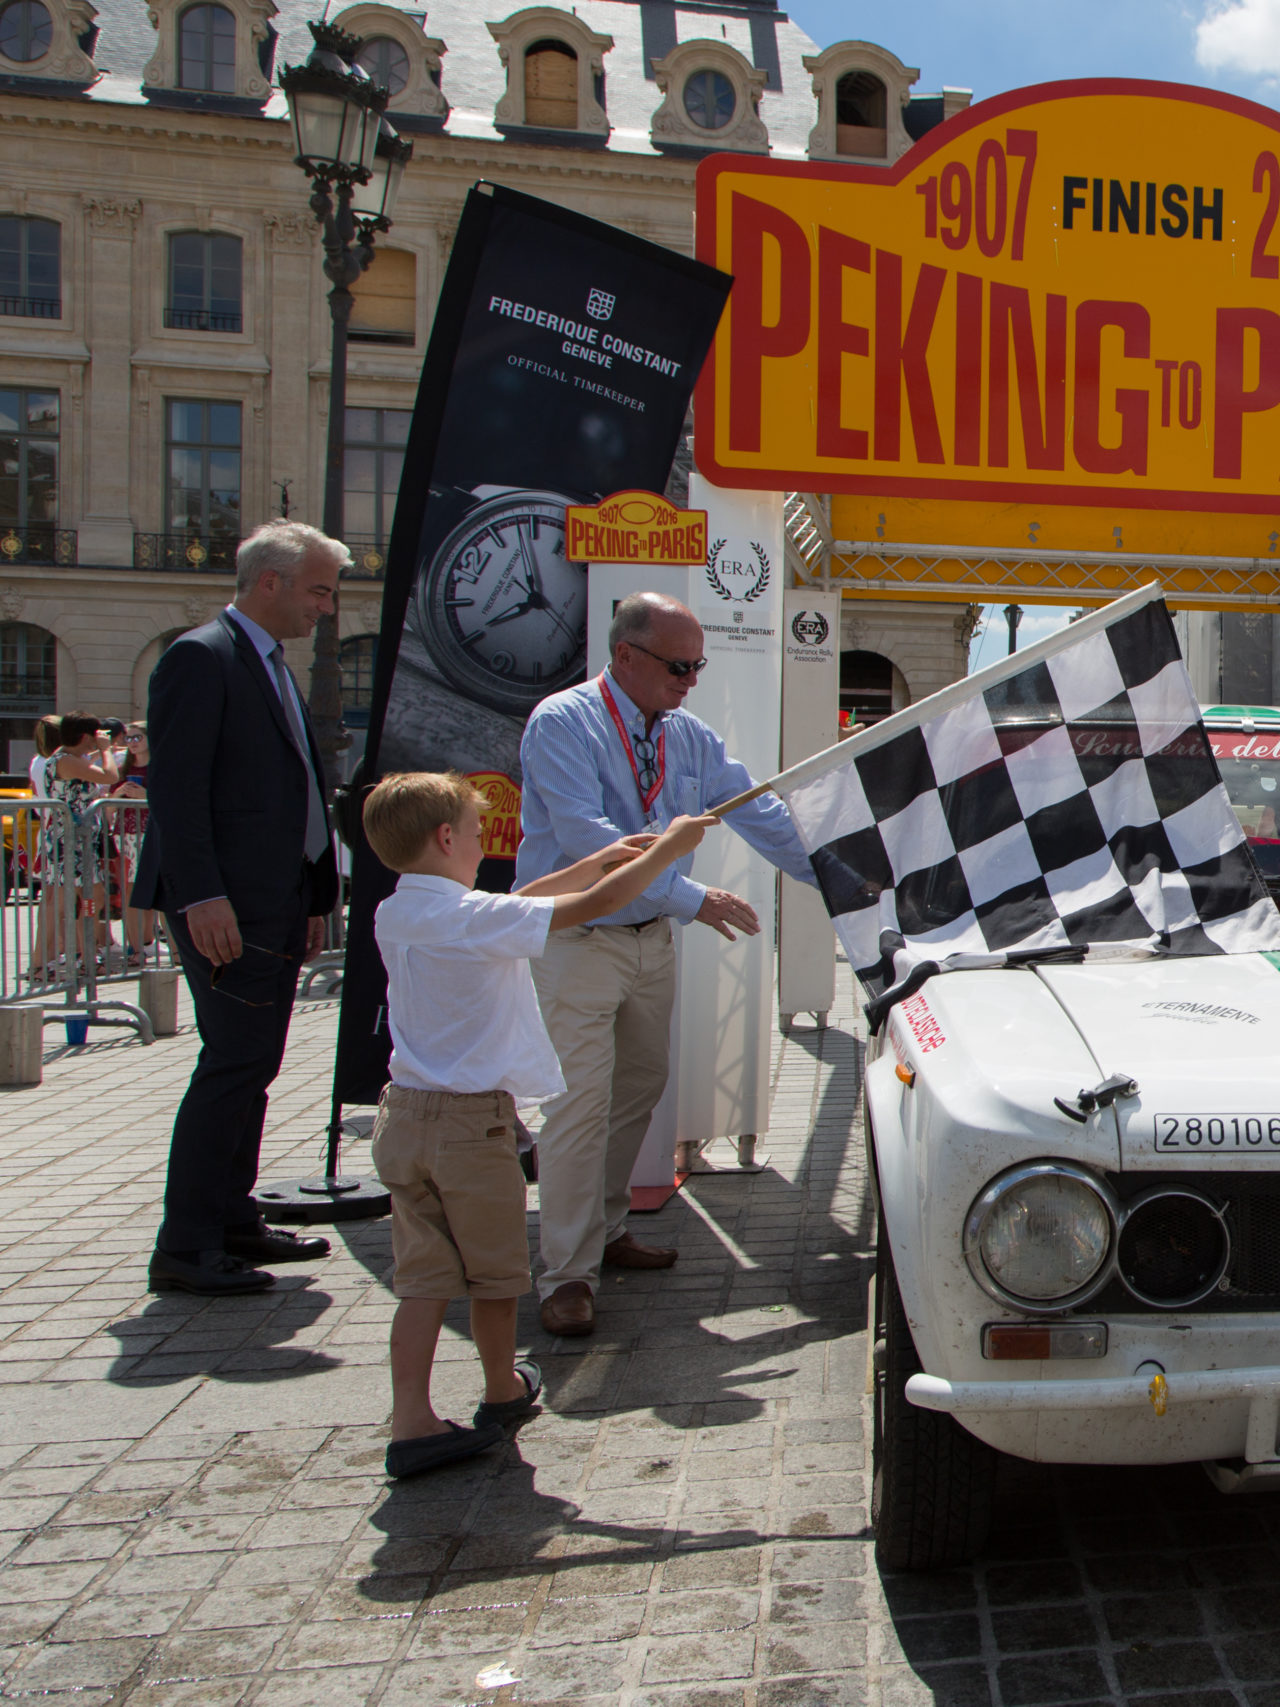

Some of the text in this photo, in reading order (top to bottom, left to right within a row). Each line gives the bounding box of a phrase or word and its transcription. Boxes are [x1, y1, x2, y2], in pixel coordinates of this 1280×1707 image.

[915, 128, 1038, 262] 1907
[1061, 174, 1225, 242] FINISH
[488, 296, 682, 378] FREDERIQUE CONSTANT
[728, 189, 1151, 478] PEKING
[1154, 359, 1203, 430] TO
[561, 341, 614, 369] GENEVE
[506, 354, 646, 413] OFFICIAL TIMEKEEPER
[598, 503, 678, 526] 1907 2016
[571, 516, 639, 559] PEKING
[648, 522, 703, 560] PARIS
[721, 560, 756, 577] ERA
[700, 624, 776, 637] FREDERIQUE CONSTANT
[797, 621, 824, 635] ERA
[501, 787, 521, 814] 201
